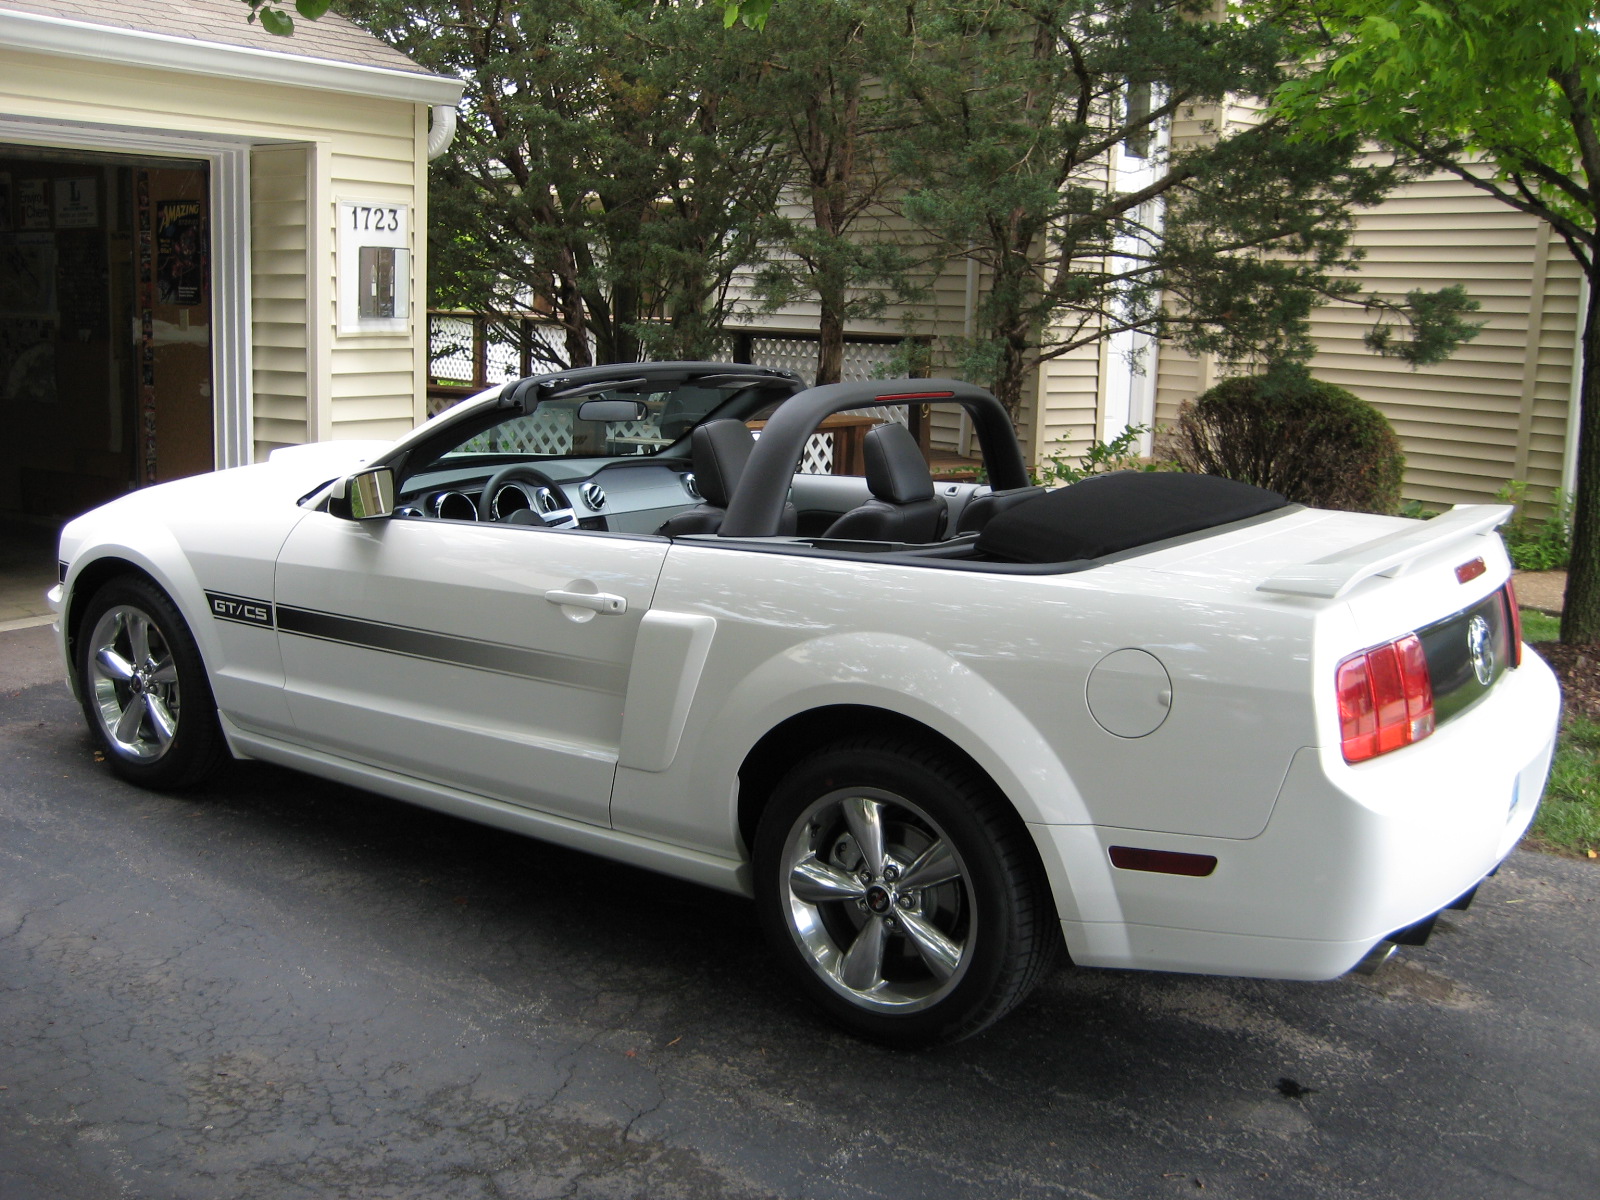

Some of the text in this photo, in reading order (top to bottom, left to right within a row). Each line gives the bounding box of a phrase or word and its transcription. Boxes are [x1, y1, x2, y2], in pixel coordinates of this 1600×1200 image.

[159, 204, 200, 232] AMAZING
[352, 206, 399, 231] 1723
[214, 599, 267, 620] GT/CS
